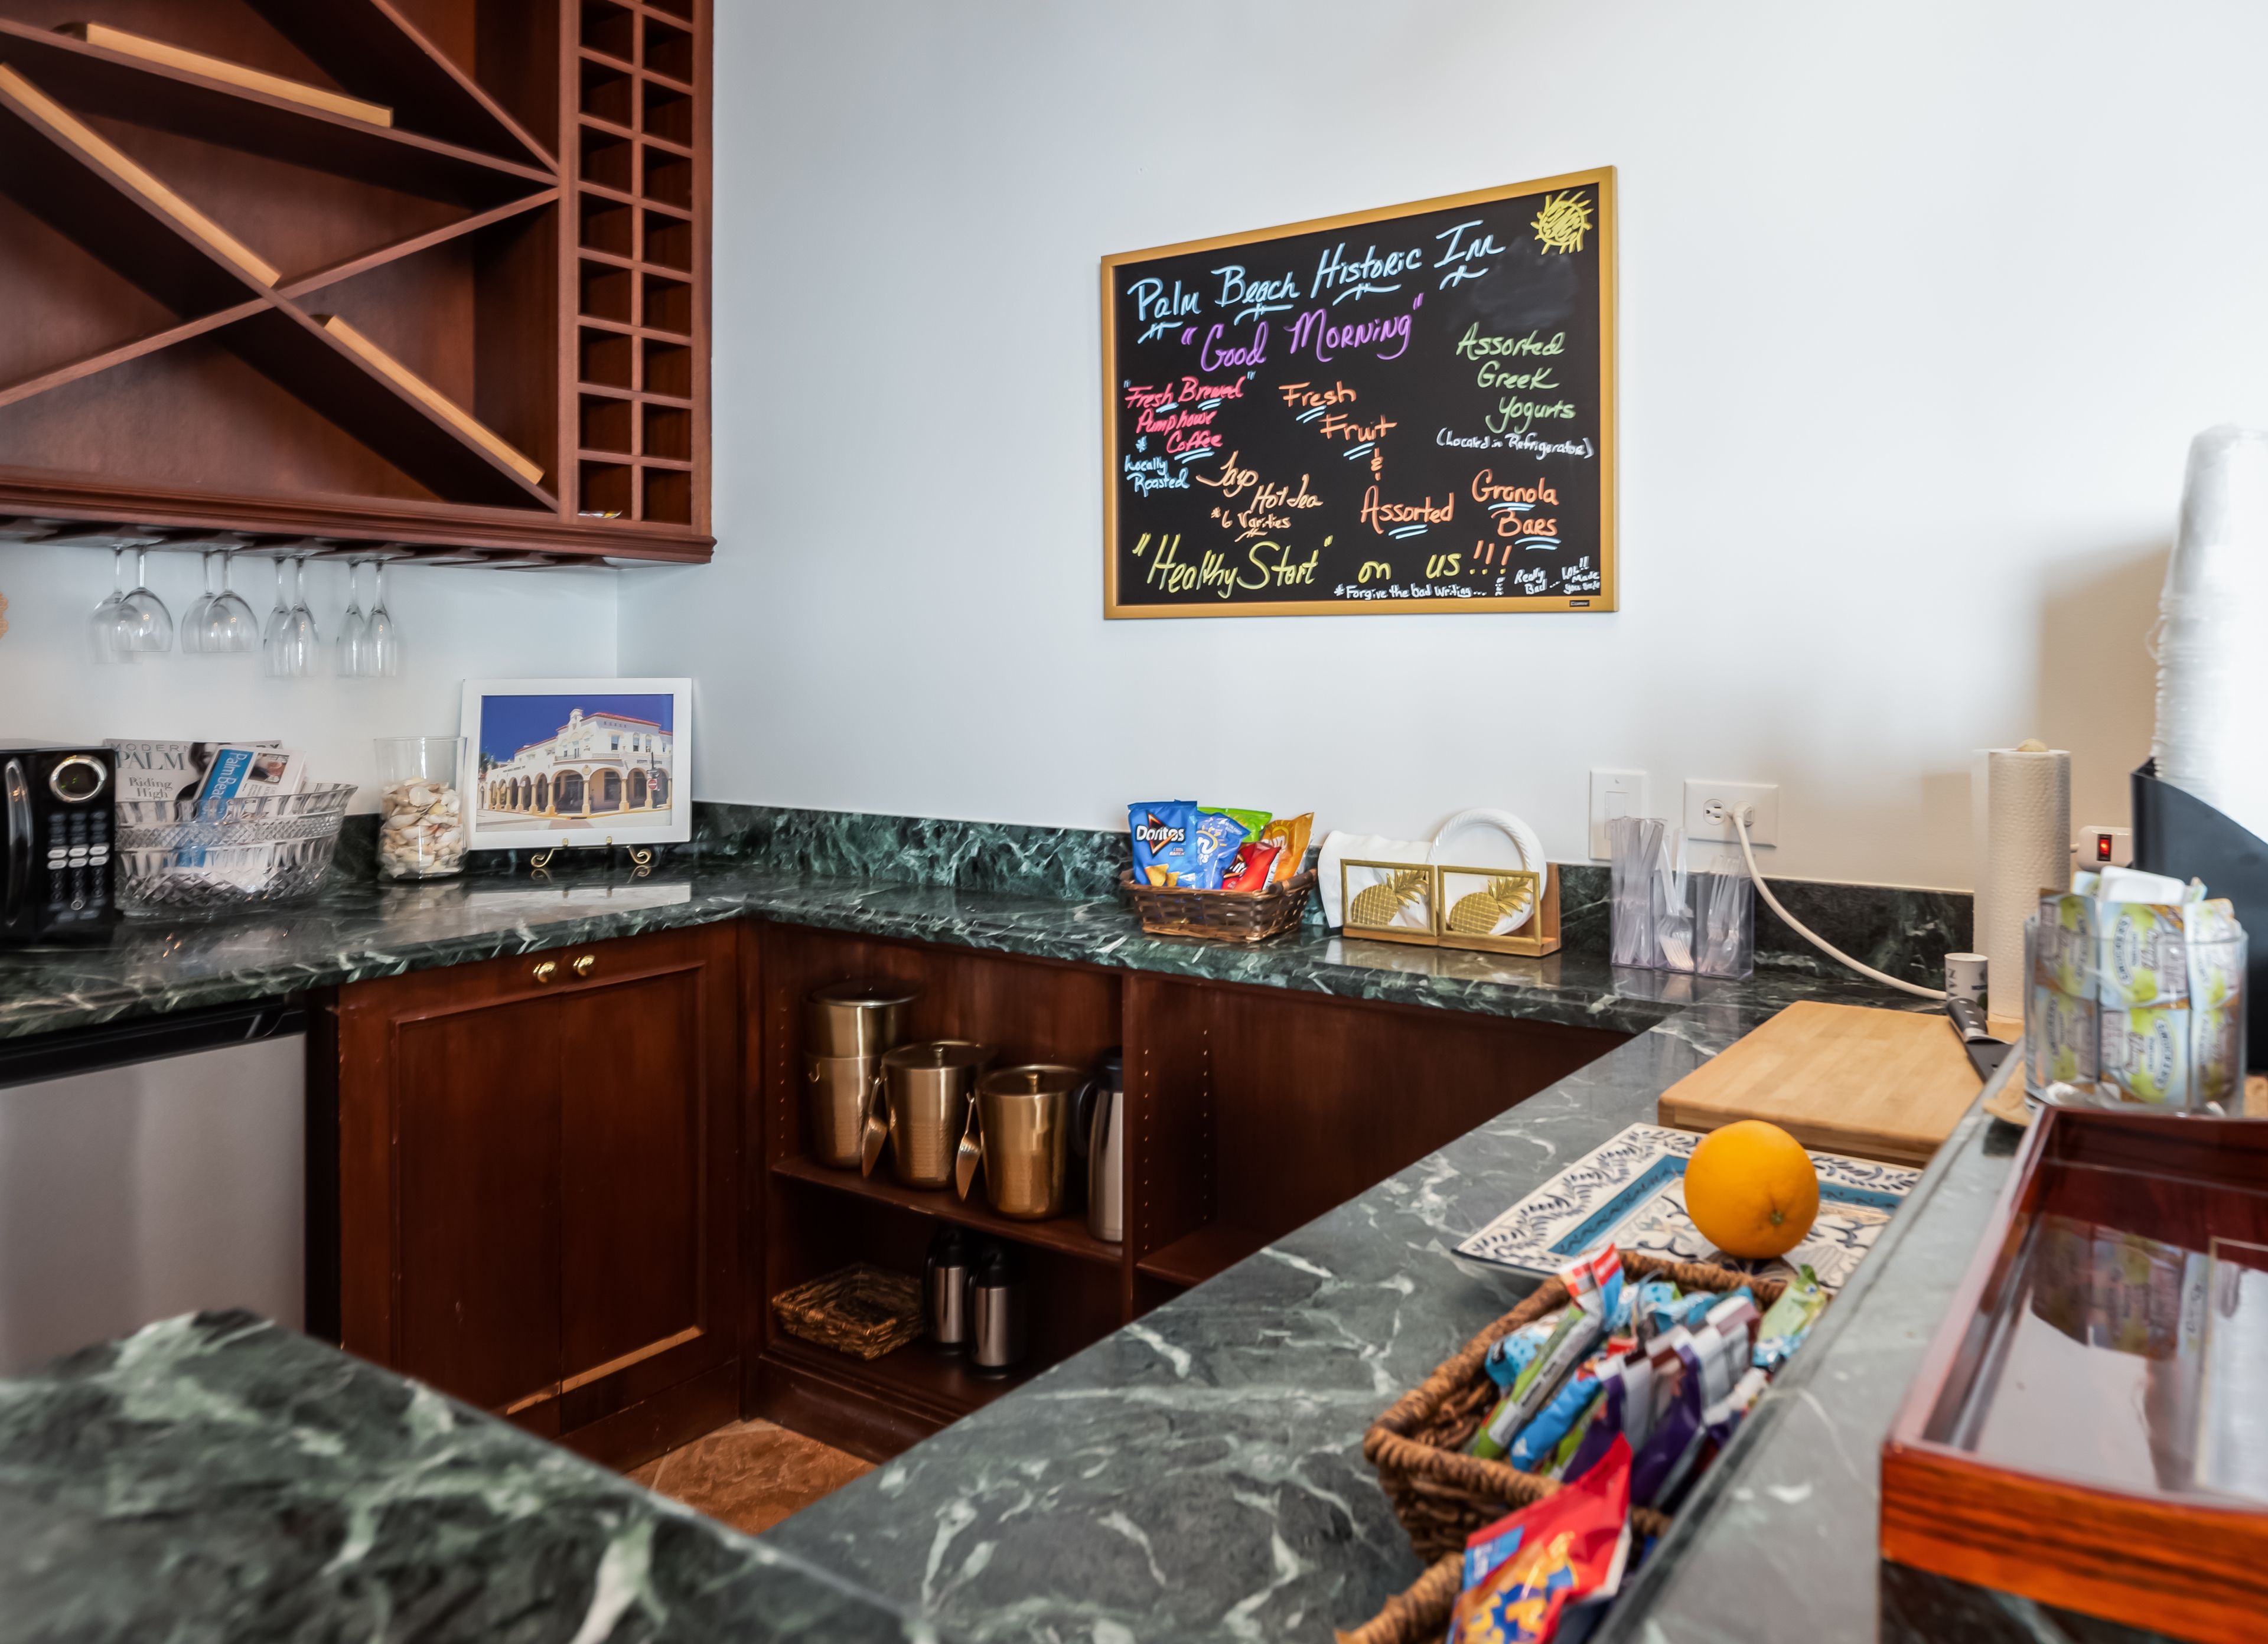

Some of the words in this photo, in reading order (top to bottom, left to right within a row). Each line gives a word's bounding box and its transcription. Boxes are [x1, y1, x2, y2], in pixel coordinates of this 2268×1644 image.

[1127, 278, 1201, 321] Palm
[1211, 265, 1300, 307] Beach
[1433, 220, 1506, 268] Inn
[1456, 322, 1566, 361] Assorted
[1477, 360, 1560, 390] Greek
[1279, 380, 1357, 407] Fresh
[1318, 413, 1397, 441] Fruit
[1485, 396, 1576, 434] Yogurts
[1166, 429, 1223, 454] Coffee
[1125, 454, 1168, 476] Locally
[1126, 467, 1190, 497] Roasted
[1471, 468, 1560, 505] Granola
[1250, 482, 1289, 514] Hot
[1360, 485, 1455, 534] Assorted
[1358, 561, 1392, 583] on
[1514, 567, 1546, 585] Really
[1389, 584, 1410, 598] the
[1410, 582, 1432, 598] bad
[115, 750, 186, 771] PALM
[128, 776, 173, 791] Riding
[136, 787, 168, 800] High
[1136, 825, 1185, 841] Doritos
